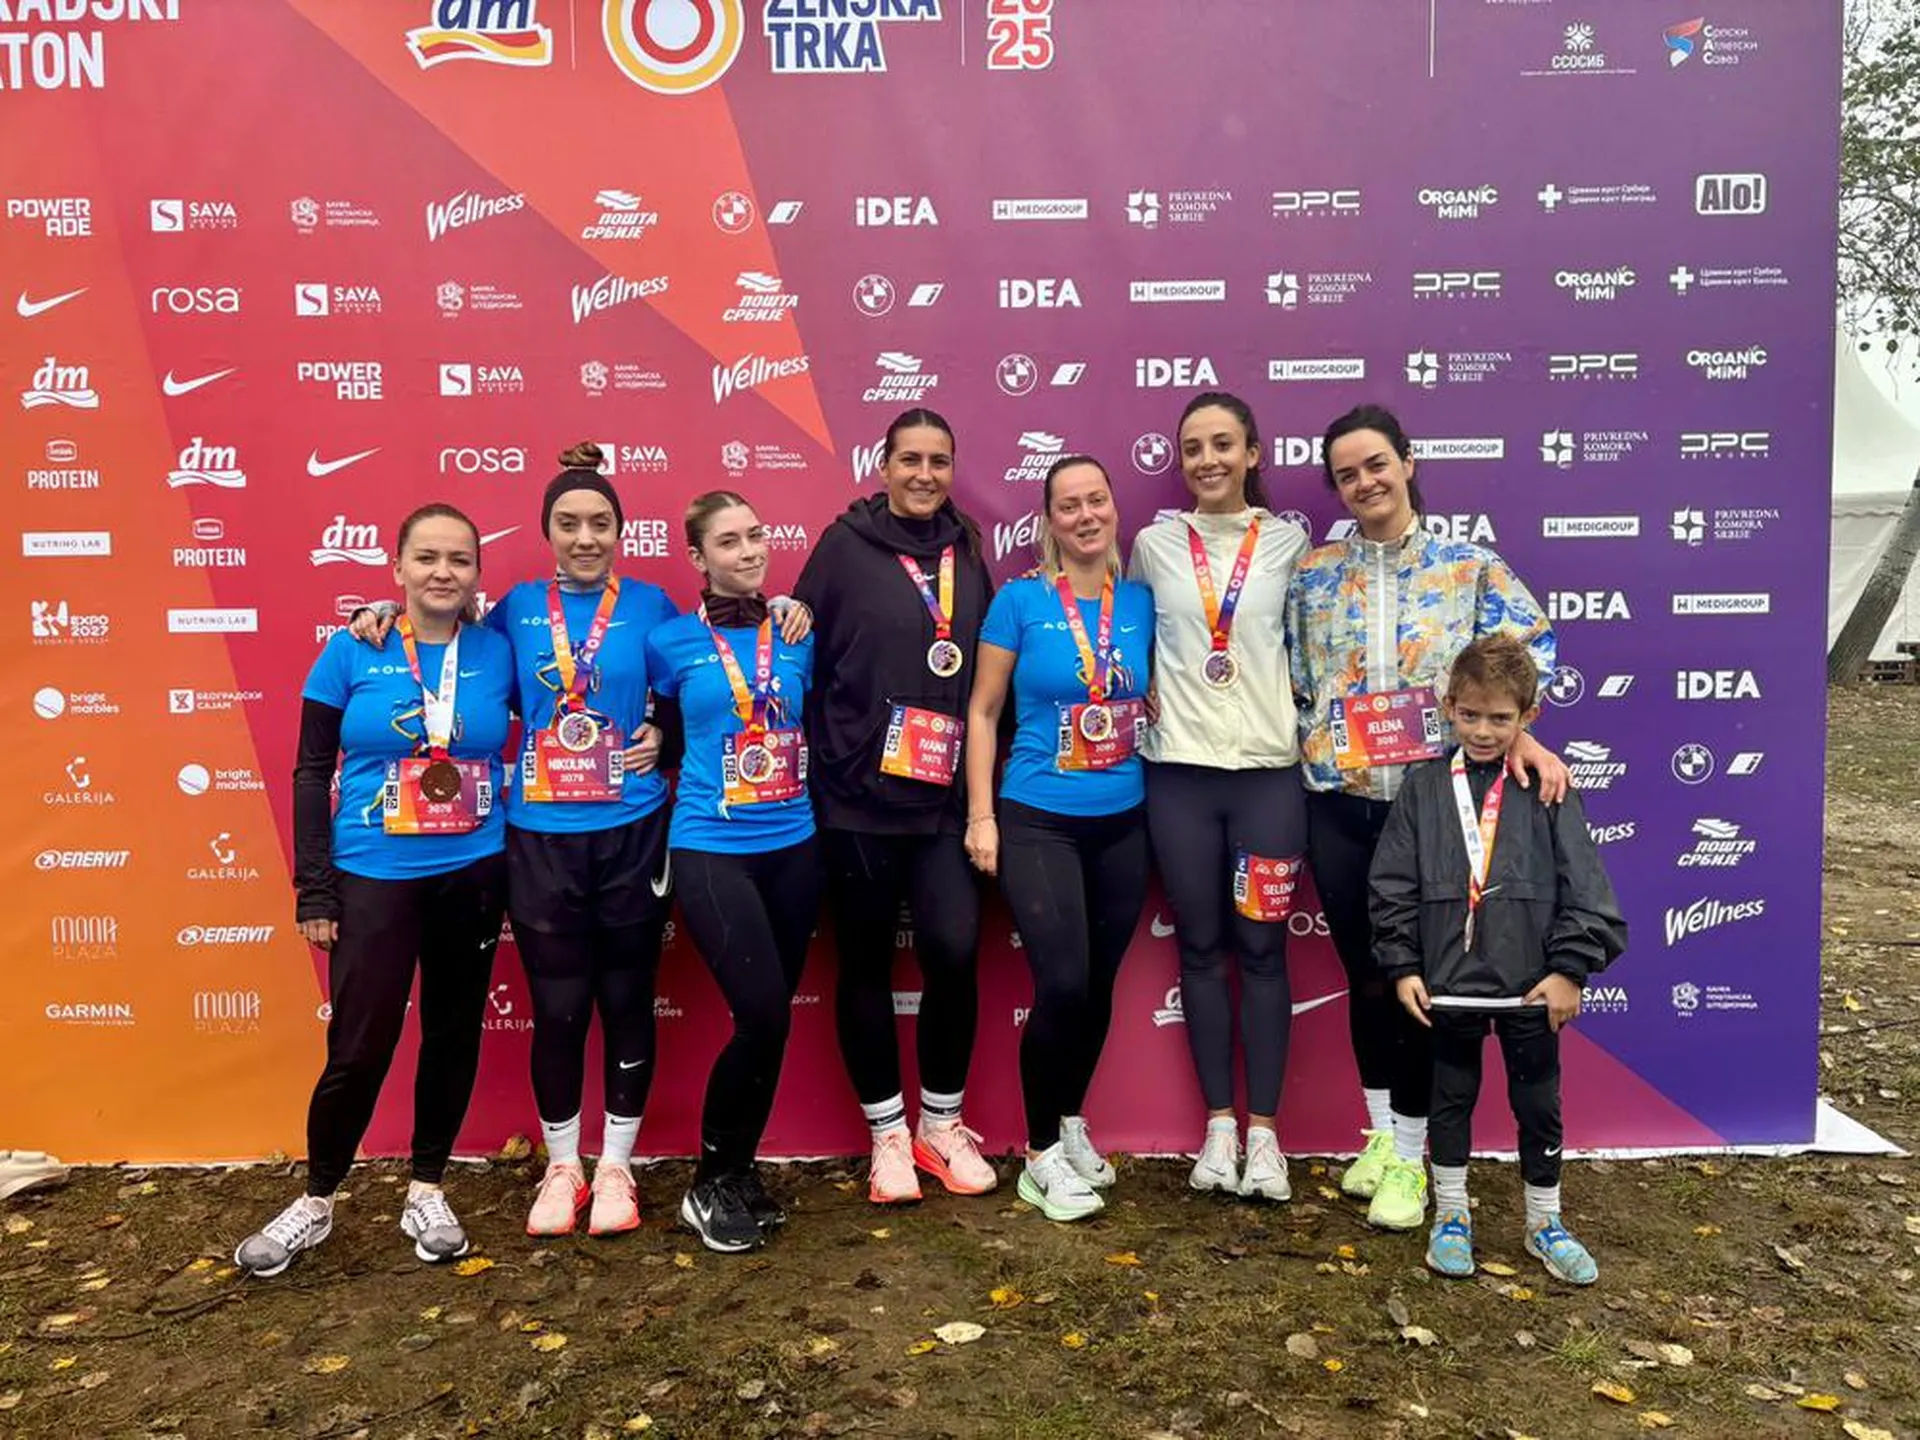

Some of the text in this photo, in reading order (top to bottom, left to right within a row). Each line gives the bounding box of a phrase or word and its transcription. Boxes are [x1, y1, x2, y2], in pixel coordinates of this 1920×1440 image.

[768, 22, 882, 68] TRKA
[990, 21, 1050, 67] 25
[0, 32, 104, 88] TON
[1169, 192, 1231, 201] PRIVREDNA
[1700, 178, 1762, 211] Alo!
[8, 199, 90, 219] POWER
[190, 203, 235, 217] SAVA
[1015, 205, 1083, 215] MEDIGROUP
[1169, 202, 1216, 211] KOMORA
[427, 192, 523, 241] Wellness
[599, 213, 657, 225] ПОШТА
[1169, 213, 1203, 221] SRBIJE
[47, 216, 91, 236] ADE
[582, 226, 643, 238] СРБИЈЕ
[1309, 273, 1371, 284] PRIVREDNA
[334, 287, 380, 301] SAVA
[1153, 286, 1220, 296] MEDIGROUP
[1309, 283, 1355, 292] KOMORA
[153, 288, 241, 312] rosa
[572, 275, 668, 323] Wellness
[740, 295, 798, 307] ПОШТА
[1308, 294, 1342, 303] SRBIJE
[723, 309, 784, 321] СРБИЈЕ
[1449, 353, 1511, 361] PRIVREDNA
[33, 358, 89, 388] dm
[298, 363, 381, 383] POWER
[1293, 365, 1360, 375] MEDIGROUP
[1449, 363, 1495, 371] KOMORA
[478, 367, 522, 381] SAVA
[713, 354, 808, 403] Wellness
[1449, 373, 1482, 381] SRBIJE
[880, 375, 937, 387] ПОШТА
[338, 381, 382, 399] ADE
[863, 388, 924, 401] СРБИЈЕ
[1584, 432, 1648, 441] PRIVREDNA
[179, 437, 236, 469] dm
[1275, 437, 1324, 465] iDE
[1432, 443, 1498, 454] MEDIGROUP
[1584, 442, 1631, 451] KOMORA
[622, 446, 666, 461] SAVA
[1584, 452, 1618, 461] SRBIJE
[440, 448, 526, 473] rosa
[28, 470, 98, 488] PROTEIN
[1005, 468, 1049, 480] СРБИ
[1715, 510, 1778, 519] PRIVREDNA
[1567, 523, 1634, 533] MEDIGROUP
[1715, 518, 1762, 528] KOMORA
[322, 516, 378, 548] dm
[621, 520, 667, 540] WER
[1428, 515, 1496, 545] DEA
[1714, 530, 1749, 538] SRBIJE
[623, 538, 668, 556] ADE
[174, 549, 245, 566] PROTEIN
[1697, 599, 1765, 609] MEDIGROUP
[70, 615, 108, 628] EXPO
[72, 626, 108, 636] 2027
[71, 693, 105, 706] bright
[71, 703, 118, 713] marbles
[1367, 719, 1405, 734] JELENA
[547, 758, 598, 771] NIKOLINA
[216, 770, 253, 784] bright
[1573, 777, 1612, 788] БИЈЕ
[216, 780, 264, 789] marbles
[44, 792, 114, 804] GALERIJA
[1695, 841, 1755, 852] ПОШТА
[59, 851, 129, 867] ENERVIT
[1678, 854, 1741, 866] СРБИЈЕ
[187, 868, 259, 880] GALERIJA
[1666, 897, 1763, 945] Wellness
[201, 927, 273, 943] ENERVIT
[1583, 987, 1627, 1005] SAVA
